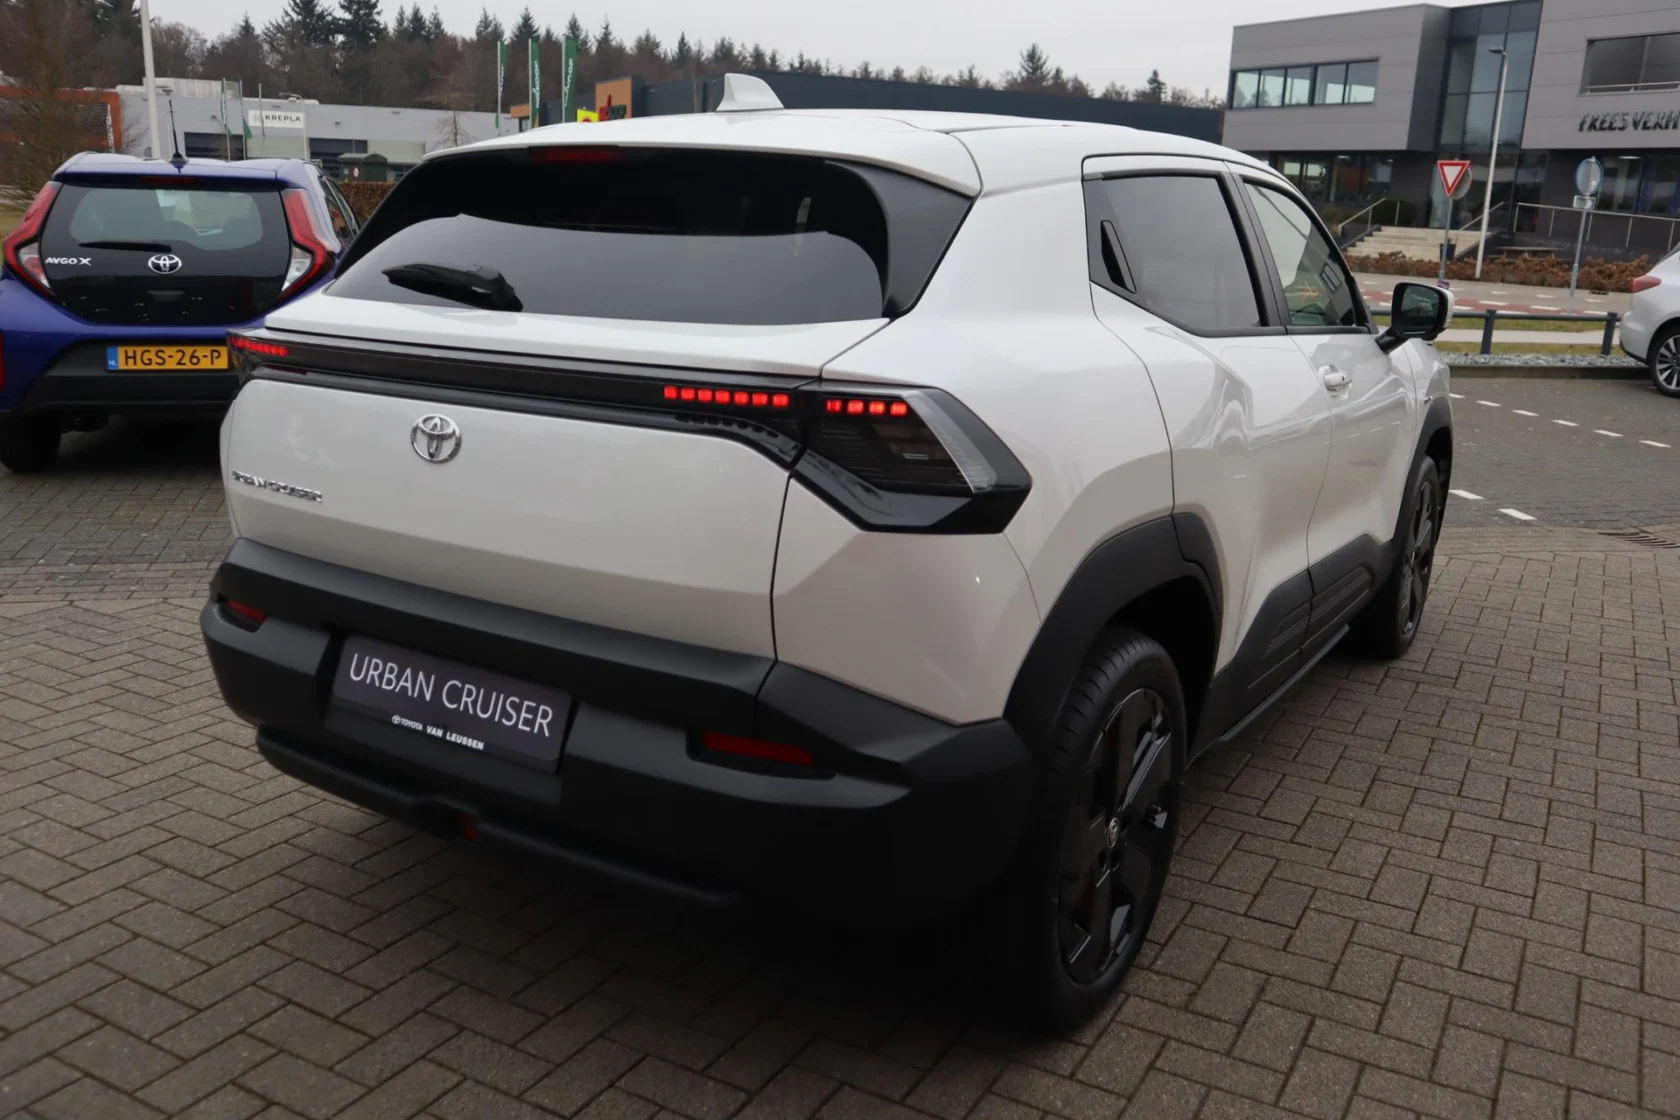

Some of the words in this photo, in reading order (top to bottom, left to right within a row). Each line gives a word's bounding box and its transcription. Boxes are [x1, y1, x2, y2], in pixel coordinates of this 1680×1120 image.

[265, 114, 301, 122] KREPLA
[45, 257, 78, 265] AYGO
[78, 257, 92, 267] X
[124, 349, 221, 366] HGS-26-P
[350, 653, 435, 702] URBAN
[442, 680, 553, 737] CRUISER
[401, 718, 423, 731] TOYOTA
[426, 725, 443, 738] VAN
[446, 732, 485, 750] LEUSSEN
